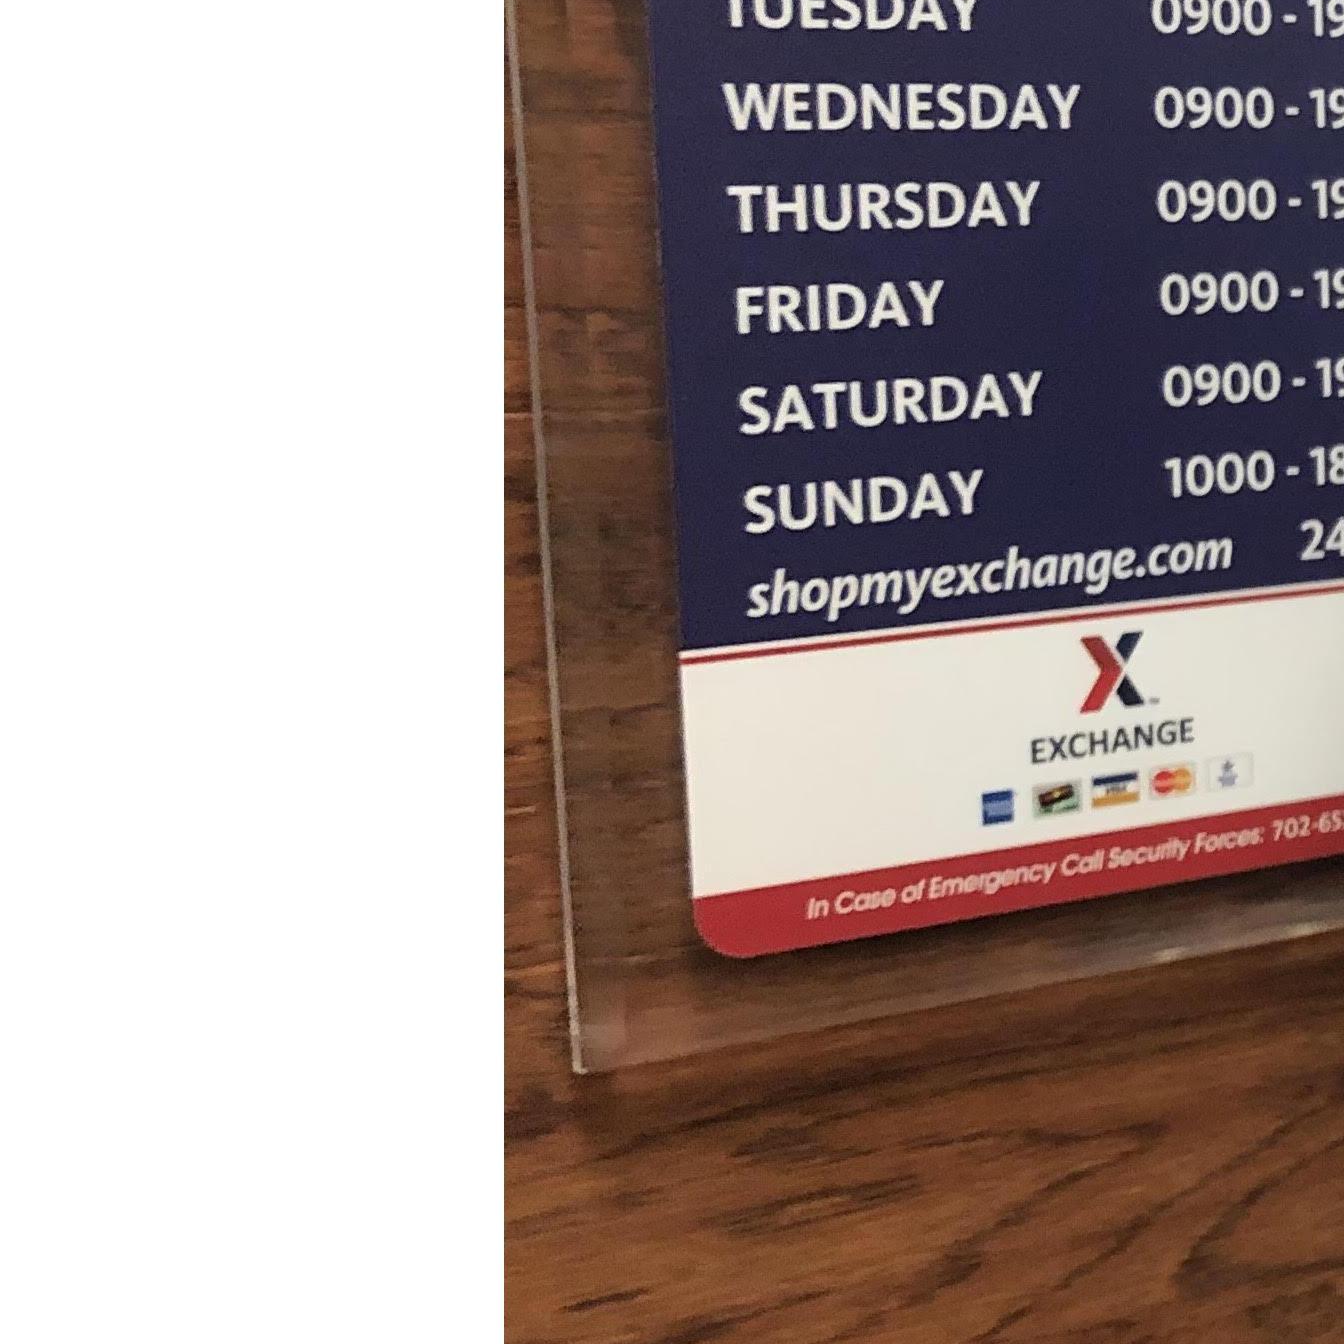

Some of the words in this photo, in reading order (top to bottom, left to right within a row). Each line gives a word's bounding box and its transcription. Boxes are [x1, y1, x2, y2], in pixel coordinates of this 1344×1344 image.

[721, 82, 1081, 131] WEDNESDAY
[1154, 86, 1275, 129] 0900
[726, 180, 1041, 233] THURSDAY
[1157, 179, 1277, 223] 0900
[735, 279, 945, 335] FRIDAY
[1160, 270, 1279, 316] 0900
[739, 370, 1043, 435] SATURDAY
[1162, 360, 1281, 407] 0900
[743, 469, 984, 534] SUNDAY
[1164, 450, 1275, 498] 1000
[746, 538, 1233, 622] shopmyexchange.com
[1030, 718, 1194, 765] EXCHANGE
[806, 897, 830, 920] In
[833, 888, 897, 915] Case
[900, 878, 926, 904] of
[927, 862, 1057, 900] Emergency
[1059, 849, 1106, 877] Call
[1107, 837, 1192, 869] Security
[1193, 827, 1264, 854] Forces:
